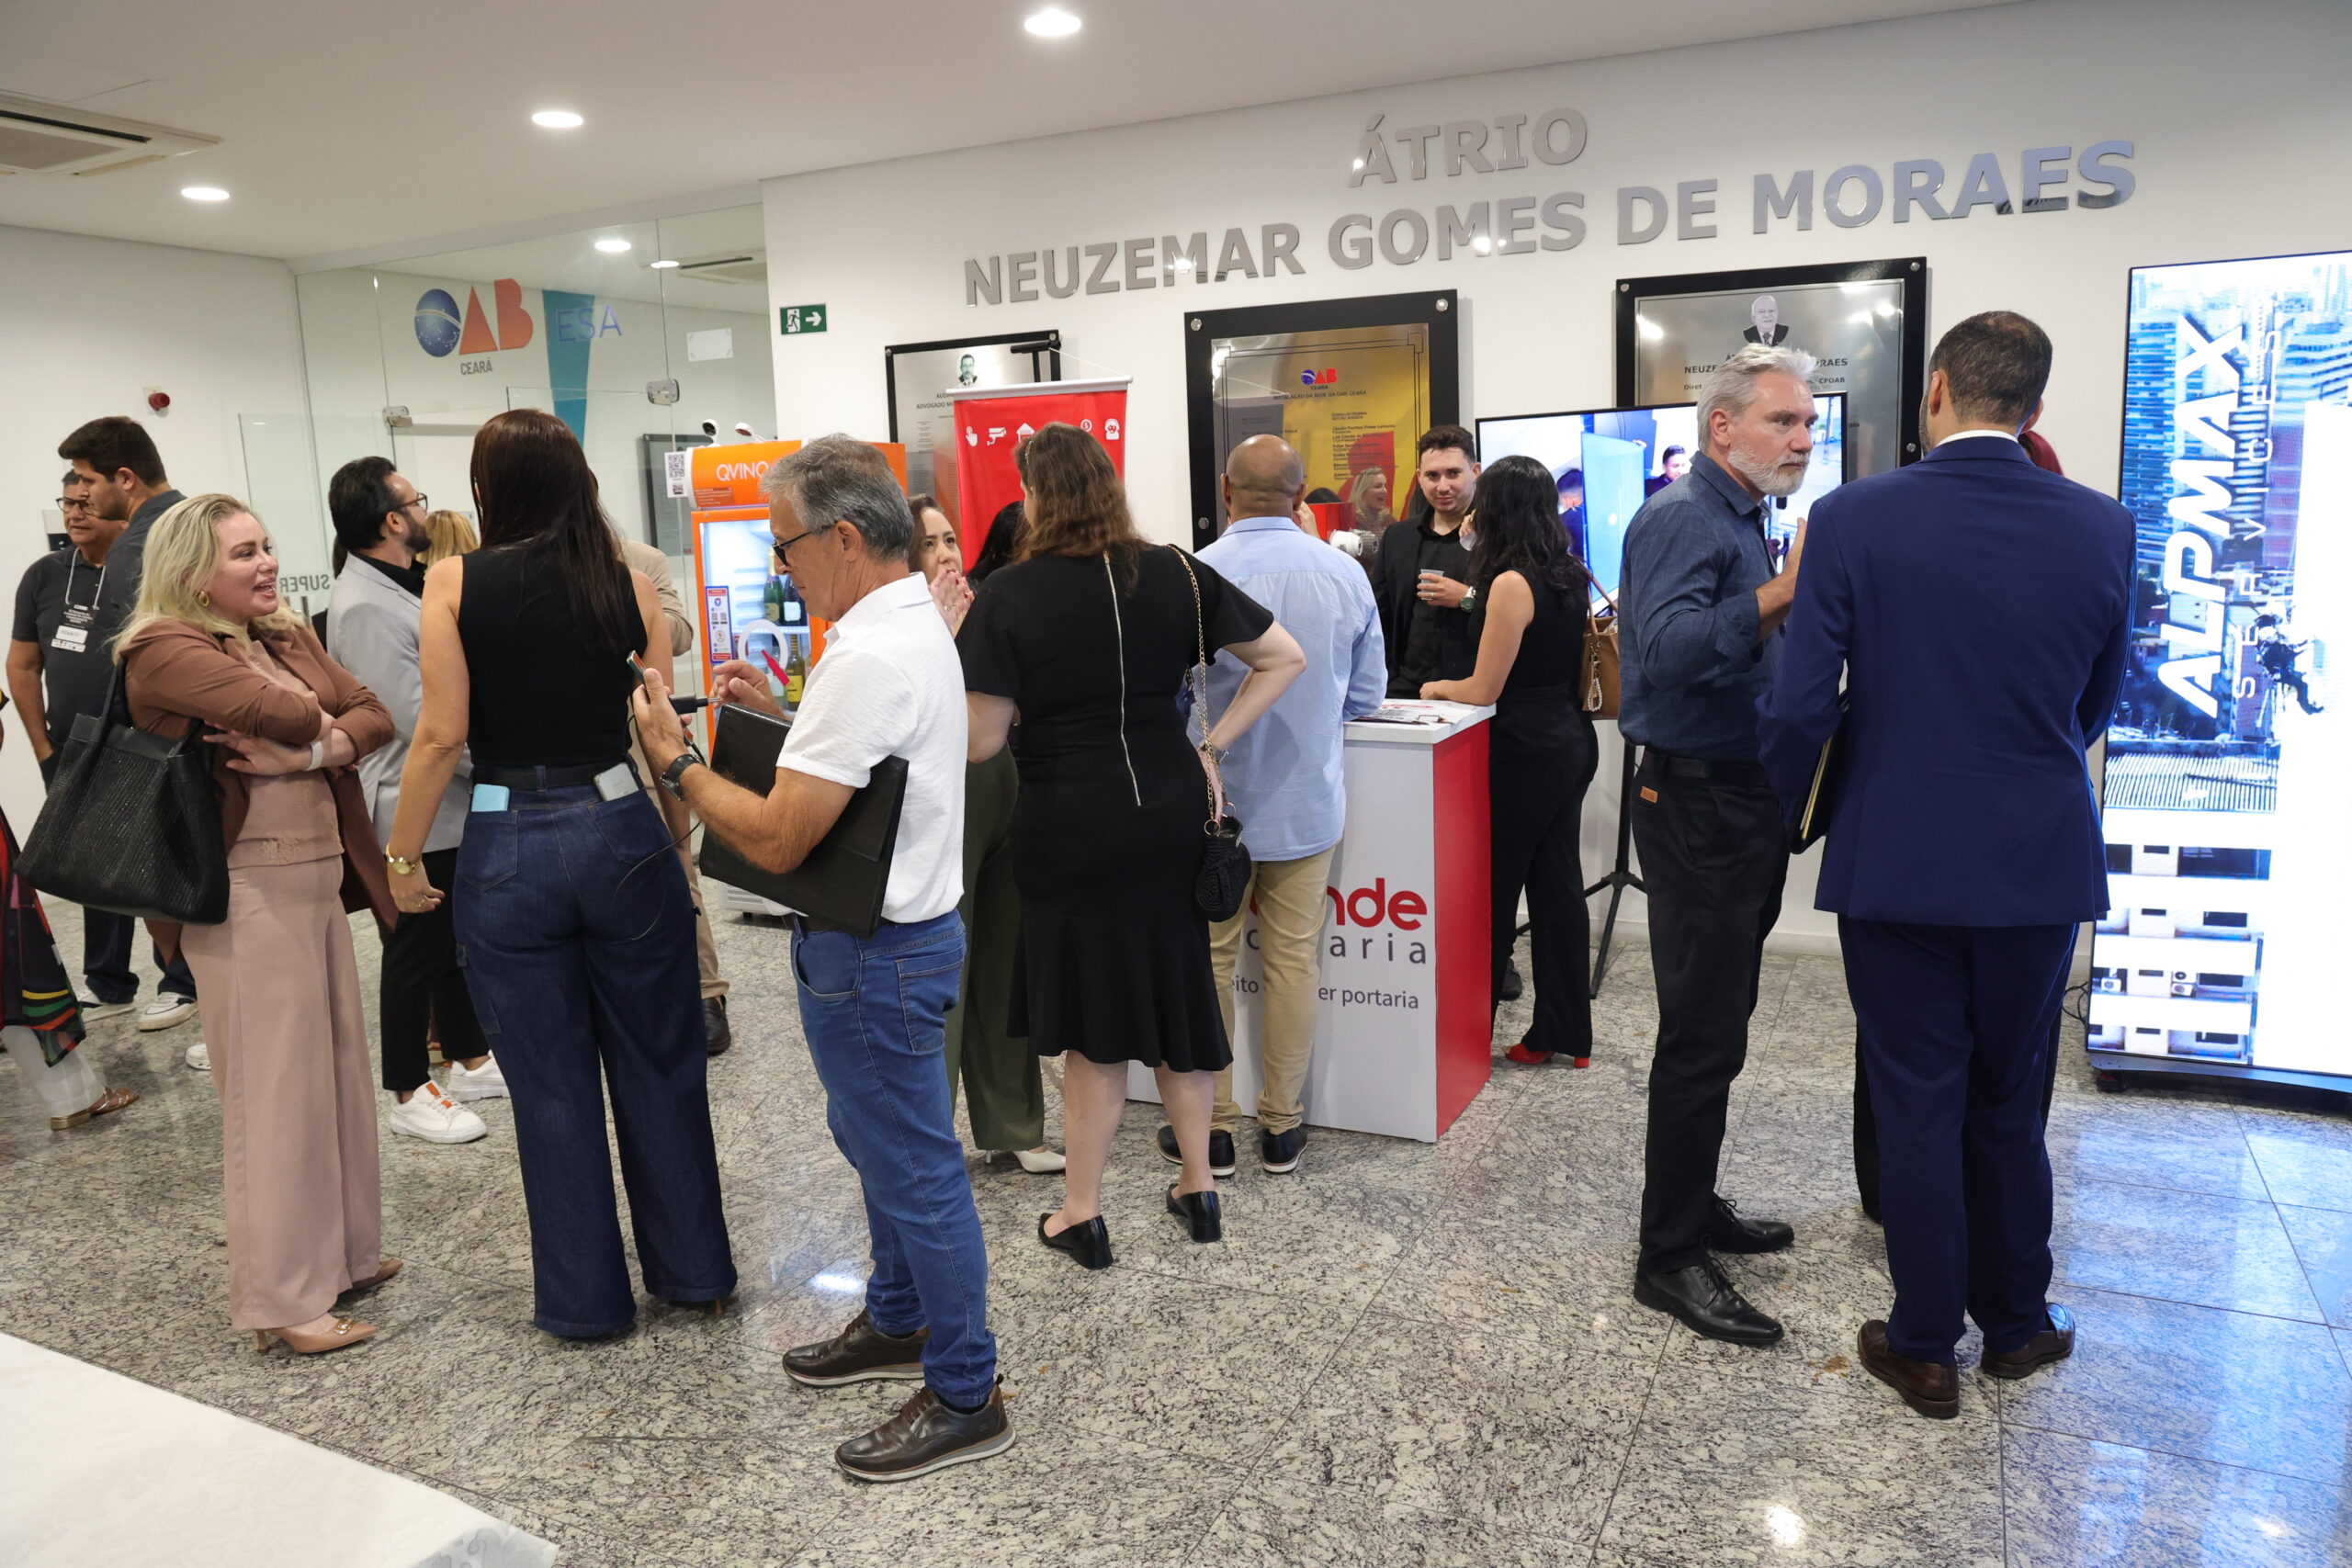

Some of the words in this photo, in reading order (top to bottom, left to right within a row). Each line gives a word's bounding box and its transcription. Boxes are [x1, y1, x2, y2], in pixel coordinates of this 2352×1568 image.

[1349, 107, 1588, 187] ÁTRIO
[964, 222, 1306, 307] NEUZEMAR
[1328, 191, 1587, 269] GOMES
[1617, 178, 1718, 245] DE
[1753, 140, 2136, 234] MORAES
[414, 277, 534, 357] OAB
[557, 304, 622, 343] ESA
[459, 356, 493, 376] CEARÁ
[1301, 367, 1338, 385] OAB
[1684, 364, 1718, 375] NEUZE
[1815, 358, 1849, 368] RAES
[2157, 313, 2244, 719] ALPMAX
[2232, 330, 2282, 700] SERVICES
[1327, 877, 1428, 931] nde
[1342, 988, 1419, 1010] portaria
